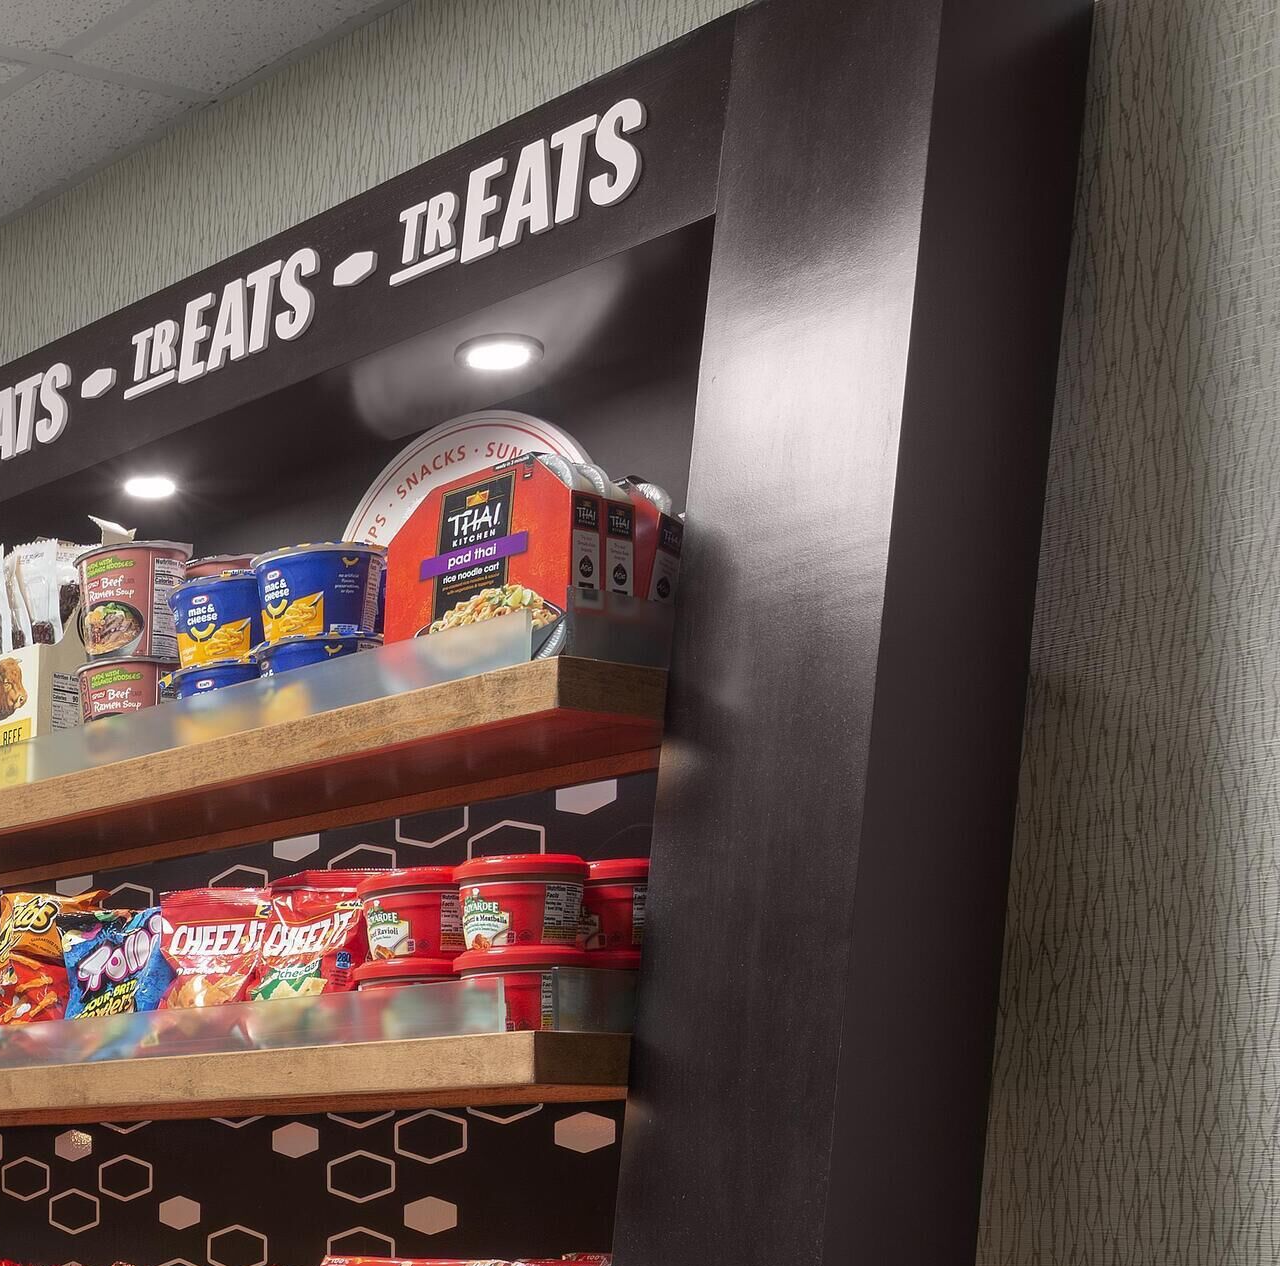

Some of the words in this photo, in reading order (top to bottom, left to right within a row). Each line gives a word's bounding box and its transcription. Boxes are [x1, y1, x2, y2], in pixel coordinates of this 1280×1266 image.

[130, 247, 321, 384] TREATS
[398, 98, 648, 266] TREATS
[396, 445, 467, 499] SNACKS
[448, 503, 501, 536] THAI
[452, 529, 496, 547] KITCHEN
[448, 550, 471, 569] pad
[474, 543, 497, 560] thai
[100, 574, 125, 589] Beef
[442, 574, 456, 584] rice
[458, 567, 483, 580] noodle
[483, 561, 500, 573] cart
[89, 589, 115, 602] Ramen
[115, 587, 135, 599] Soup
[107, 688, 131, 700] Beef
[93, 701, 121, 713] Ramen
[122, 700, 142, 712] Soup
[377, 926, 399, 936] Ravioli
